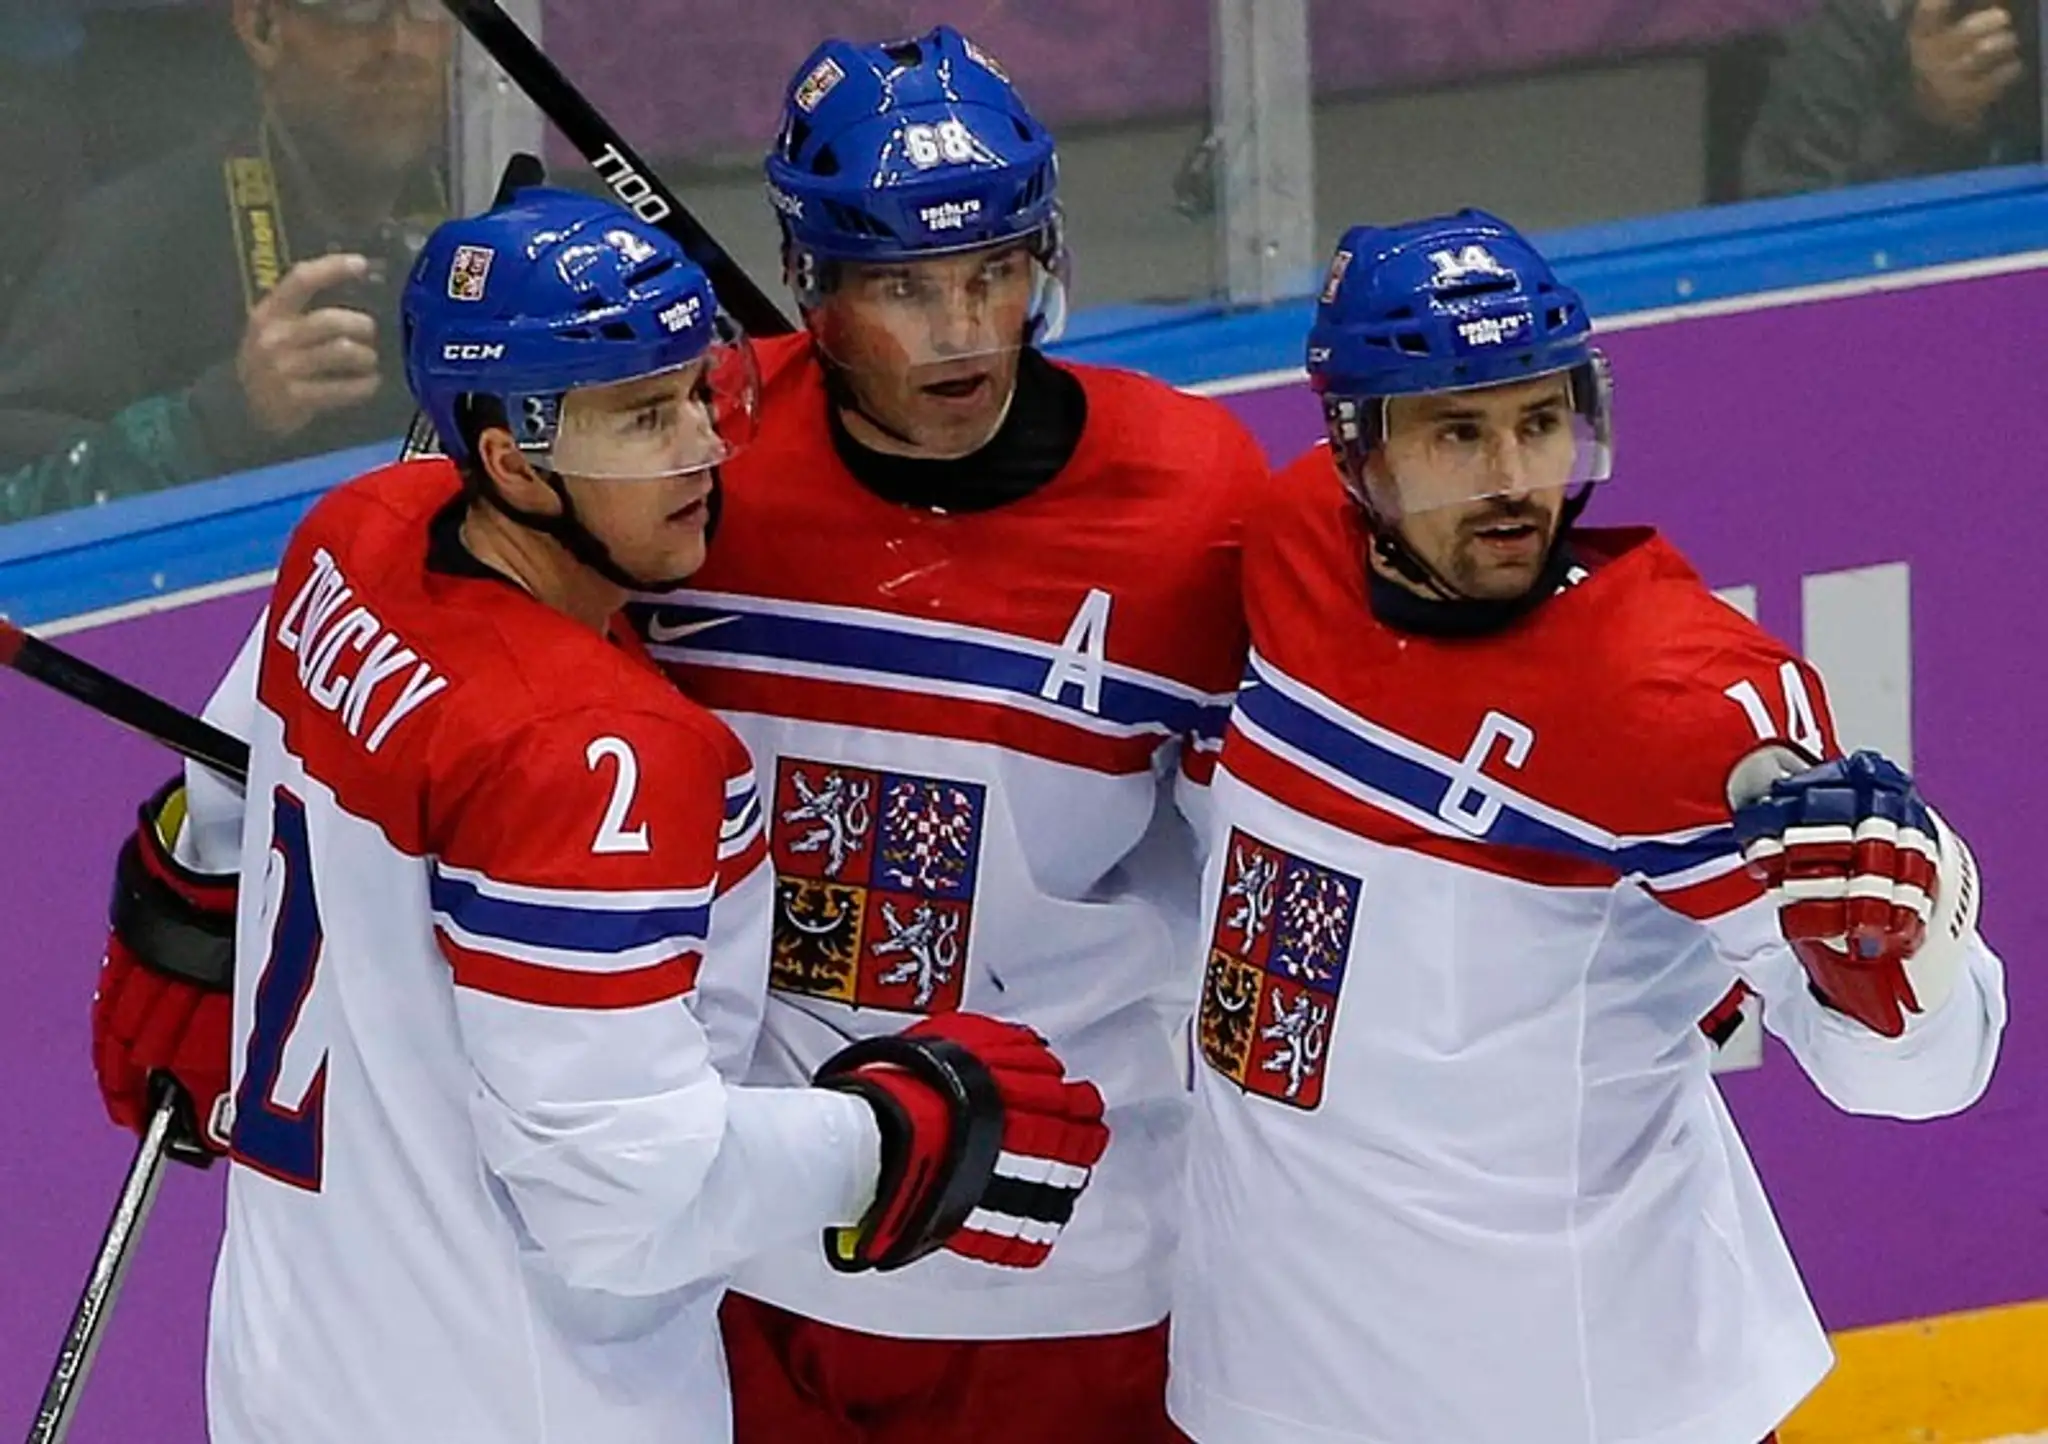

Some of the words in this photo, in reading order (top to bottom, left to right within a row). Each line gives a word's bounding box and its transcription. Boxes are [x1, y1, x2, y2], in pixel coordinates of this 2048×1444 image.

[592, 143, 670, 223] T100
[904, 121, 973, 170] 68
[604, 230, 656, 262] 2
[1428, 245, 1504, 278] 14
[443, 344, 505, 360] CCM
[1041, 587, 1112, 714] A
[1723, 661, 1825, 761] 14
[586, 735, 650, 853] 2
[1439, 710, 1535, 837] C
